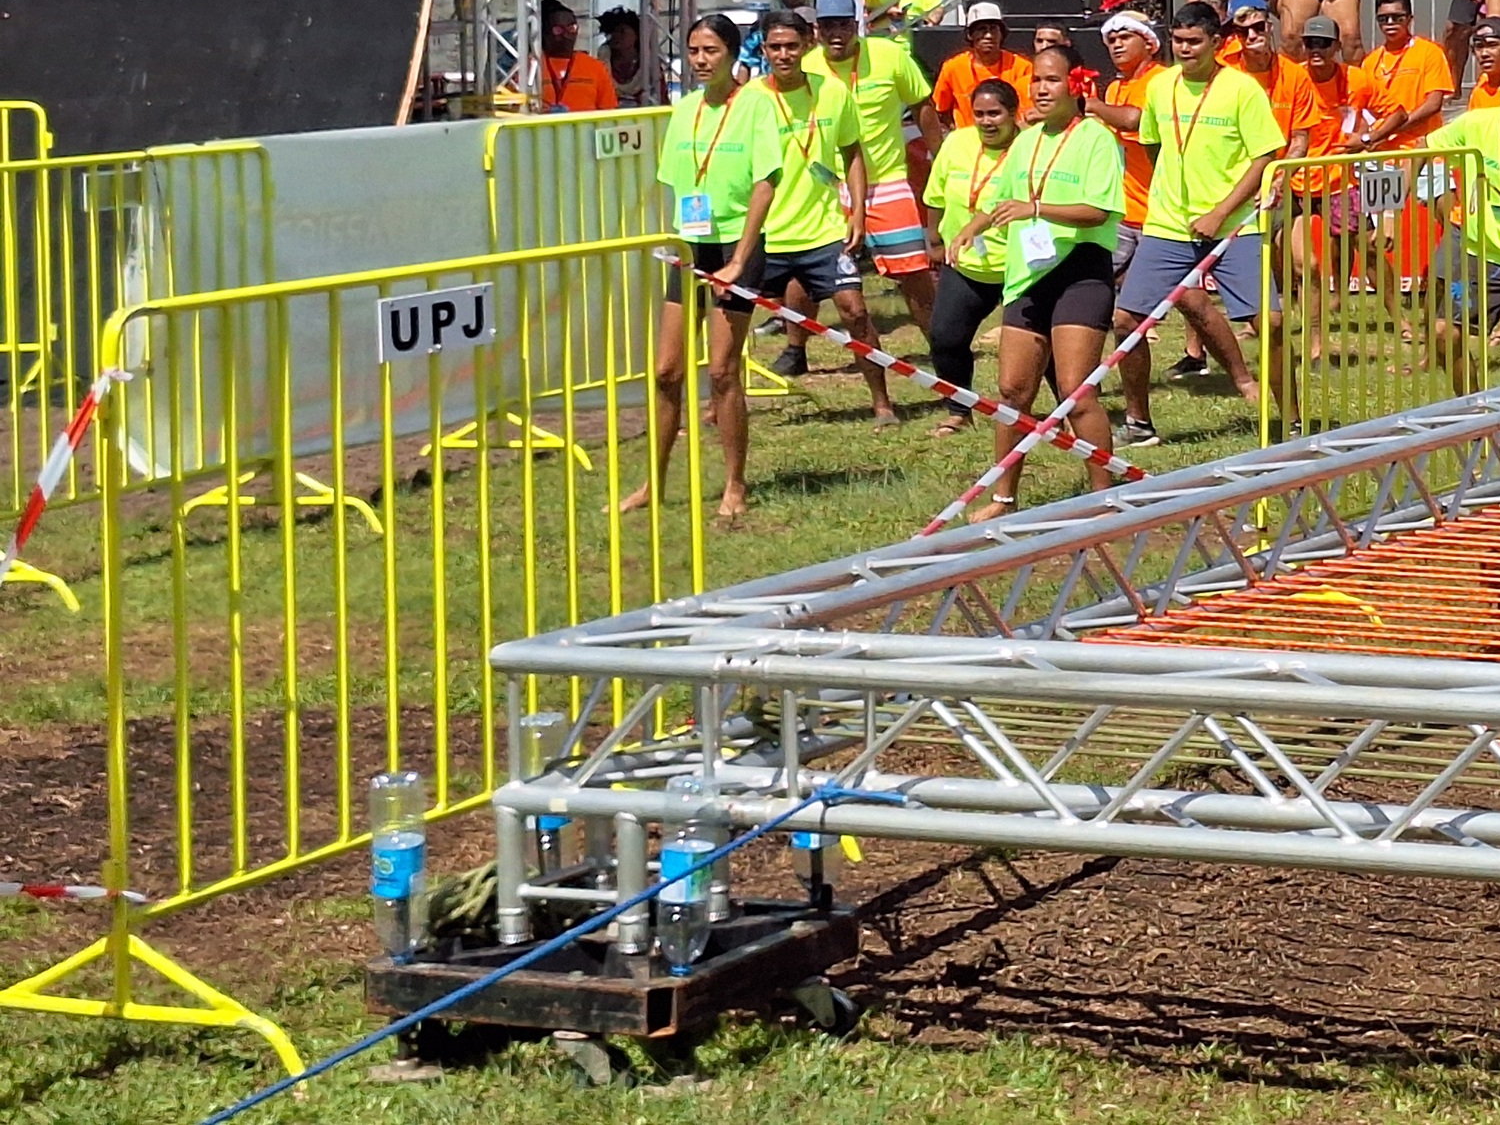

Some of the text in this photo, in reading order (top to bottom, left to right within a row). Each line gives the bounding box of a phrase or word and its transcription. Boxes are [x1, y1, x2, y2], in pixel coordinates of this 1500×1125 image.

[601, 129, 642, 154] UPJ
[1366, 176, 1402, 206] UPJ
[390, 295, 485, 352] UPJ
